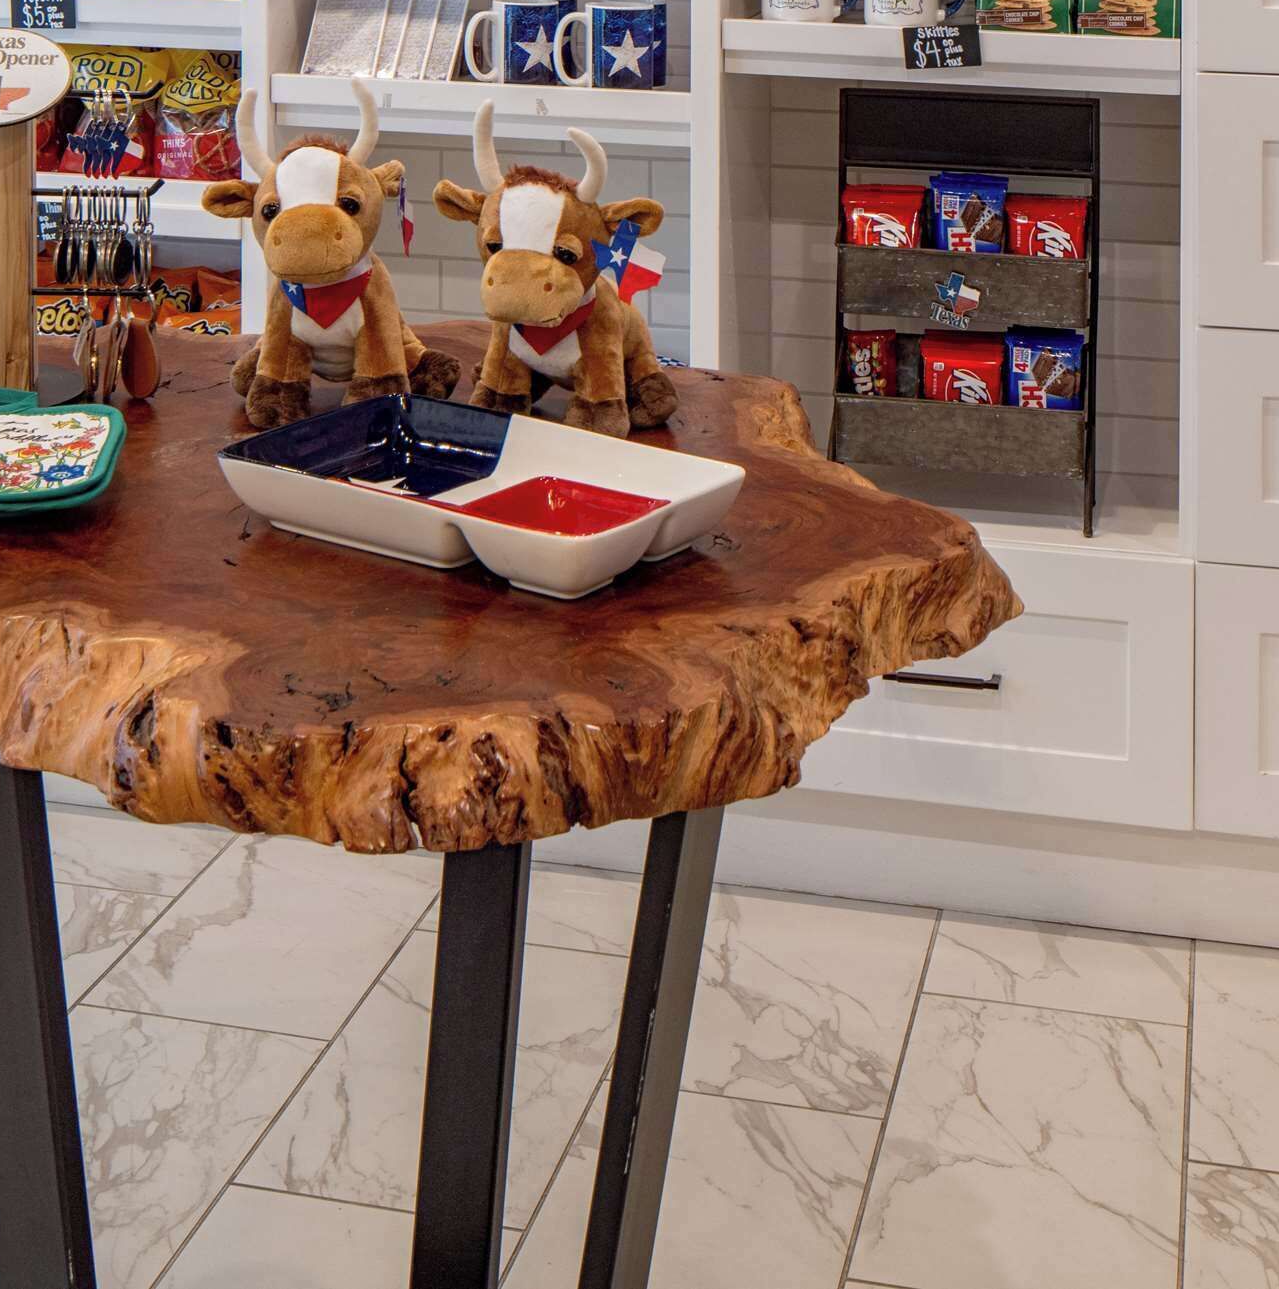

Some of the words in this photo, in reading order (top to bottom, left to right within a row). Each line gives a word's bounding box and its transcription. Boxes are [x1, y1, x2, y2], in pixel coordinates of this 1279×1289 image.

[1028, 10, 1040, 18] CHIP
[917, 27, 960, 39] Skittles
[77, 56, 136, 78] ROLD
[169, 79, 215, 101] GOLD
[161, 138, 186, 149] THINS
[157, 152, 193, 160] ORIGINAL
[930, 302, 970, 329] Texas
